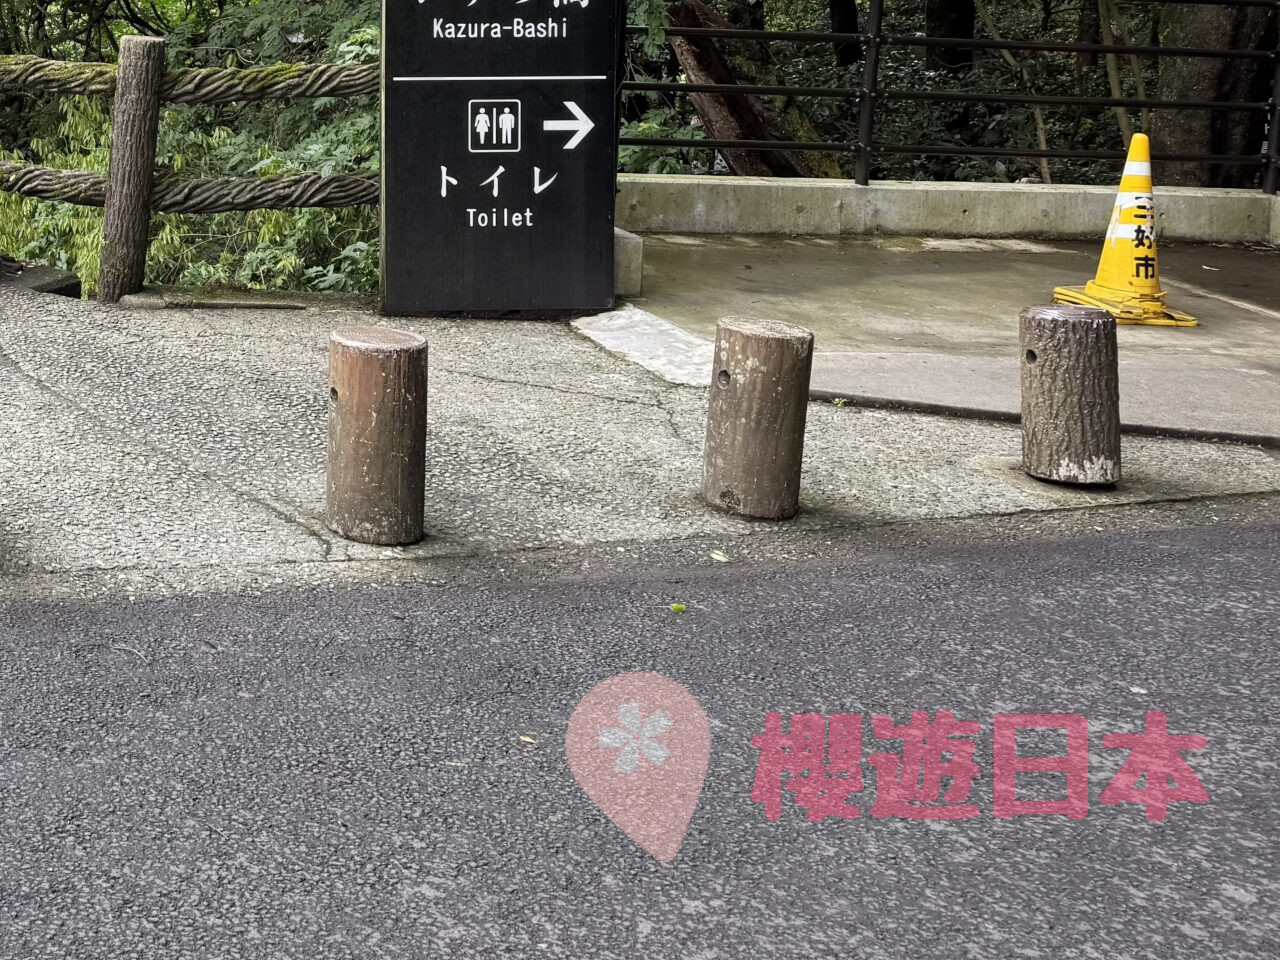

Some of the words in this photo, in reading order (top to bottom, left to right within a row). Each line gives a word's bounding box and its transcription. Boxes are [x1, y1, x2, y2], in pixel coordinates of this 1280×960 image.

[433, 17, 567, 39] Kazura-Bashi
[440, 165, 558, 198] トイレ
[466, 207, 534, 227] Toilet
